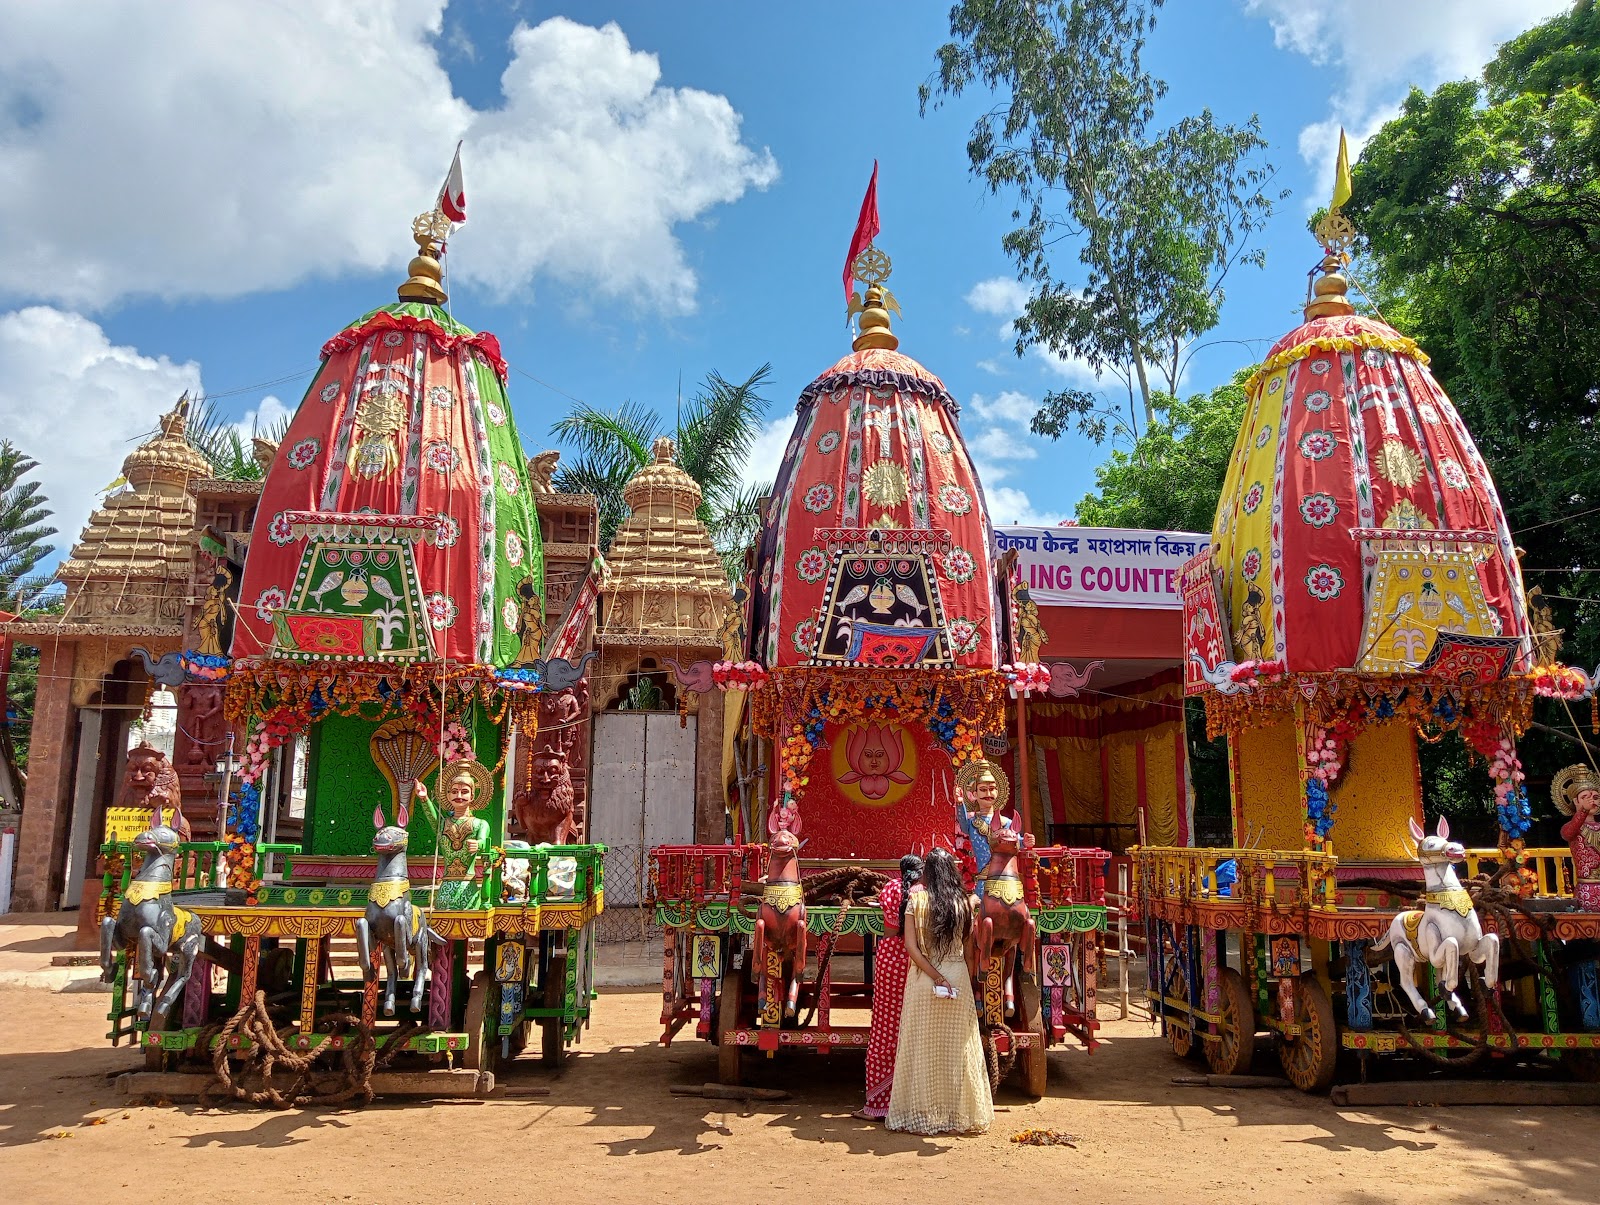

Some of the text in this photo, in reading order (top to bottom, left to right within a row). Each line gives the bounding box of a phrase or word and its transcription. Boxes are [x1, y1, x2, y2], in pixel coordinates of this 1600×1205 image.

[1042, 529, 1079, 554] केन्द्र
[1087, 537, 1152, 557] মহাপ্রসাদ
[1154, 535, 1196, 557] বিক্রয়
[1081, 566, 1187, 593] COUNTE
